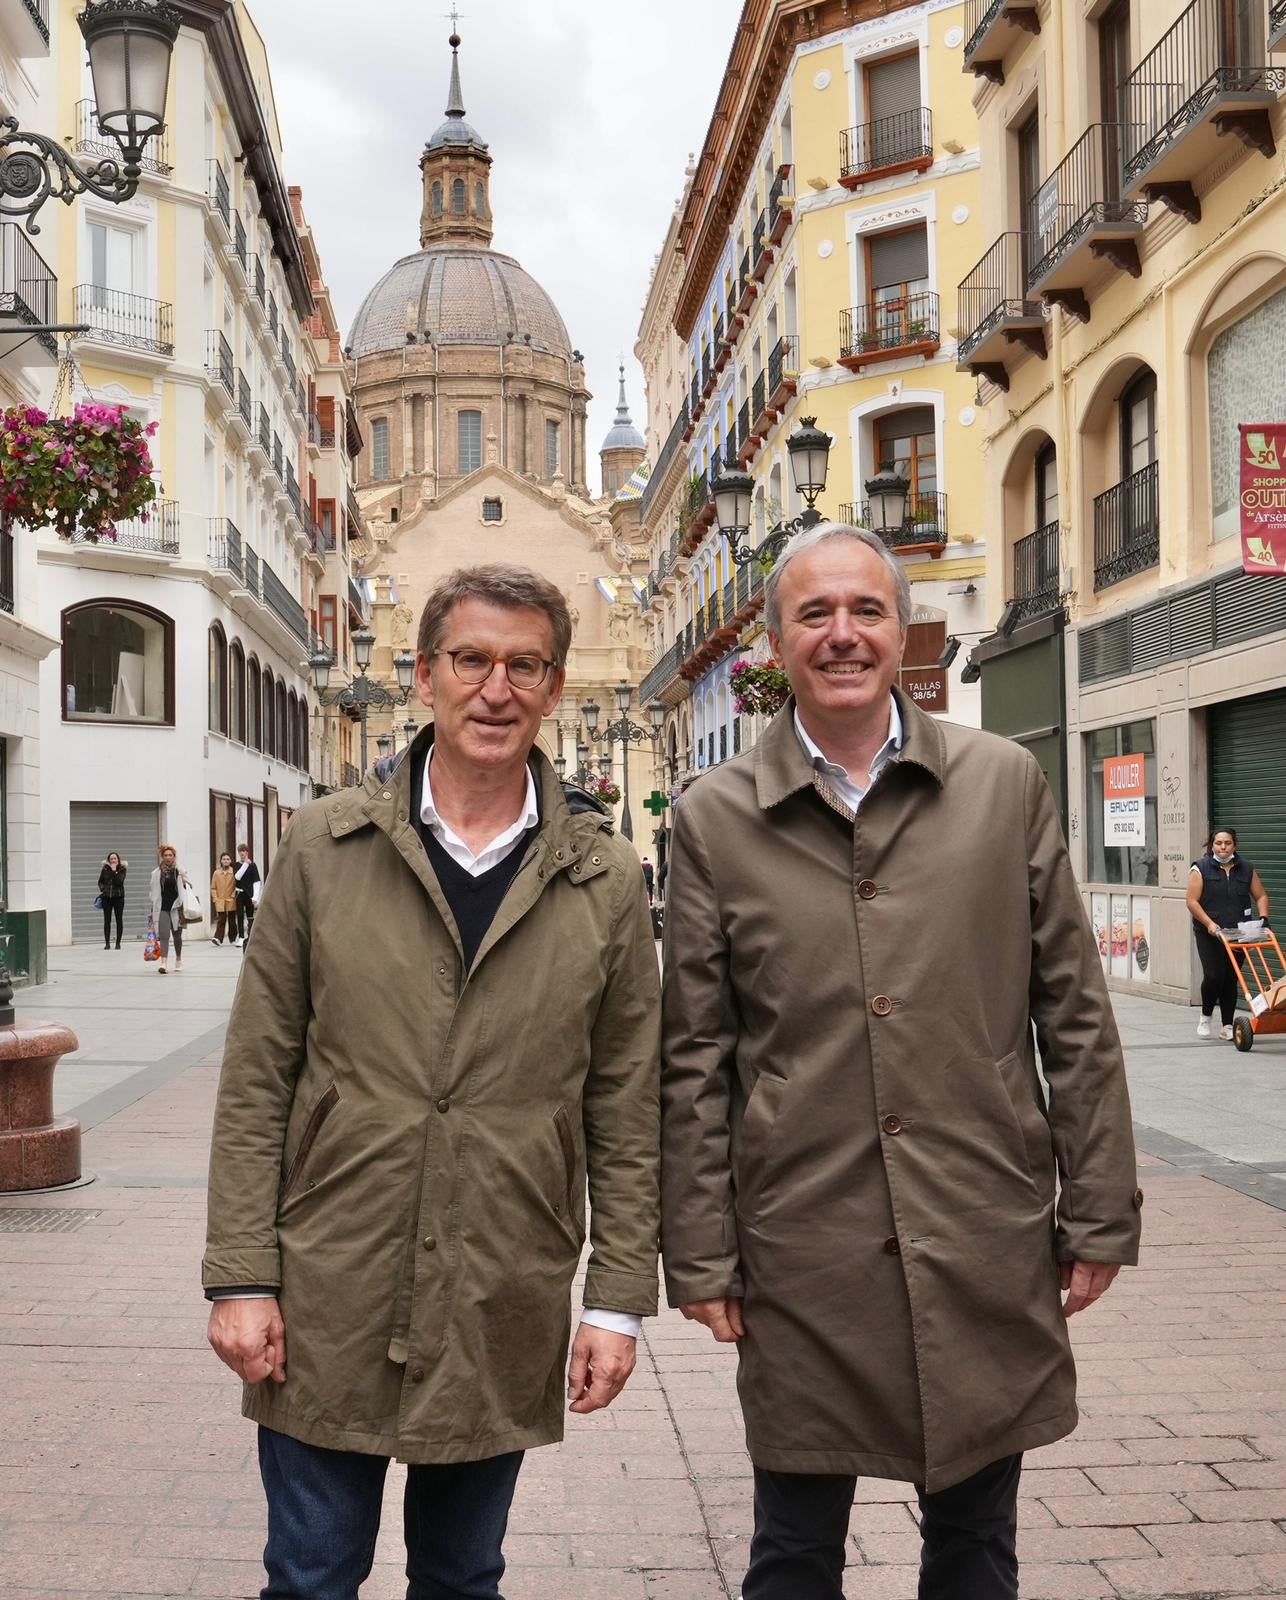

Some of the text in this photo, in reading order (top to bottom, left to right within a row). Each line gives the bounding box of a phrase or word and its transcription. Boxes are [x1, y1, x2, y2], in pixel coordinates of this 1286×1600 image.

[1258, 450, 1275, 464] 50
[1241, 489, 1286, 508] OUT
[1257, 551, 1273, 562] 40
[908, 681, 941, 691] TALLAS
[913, 690, 937, 700] 38/54
[1110, 763, 1140, 791] ALQUILER
[1110, 800, 1139, 813] SALYCO
